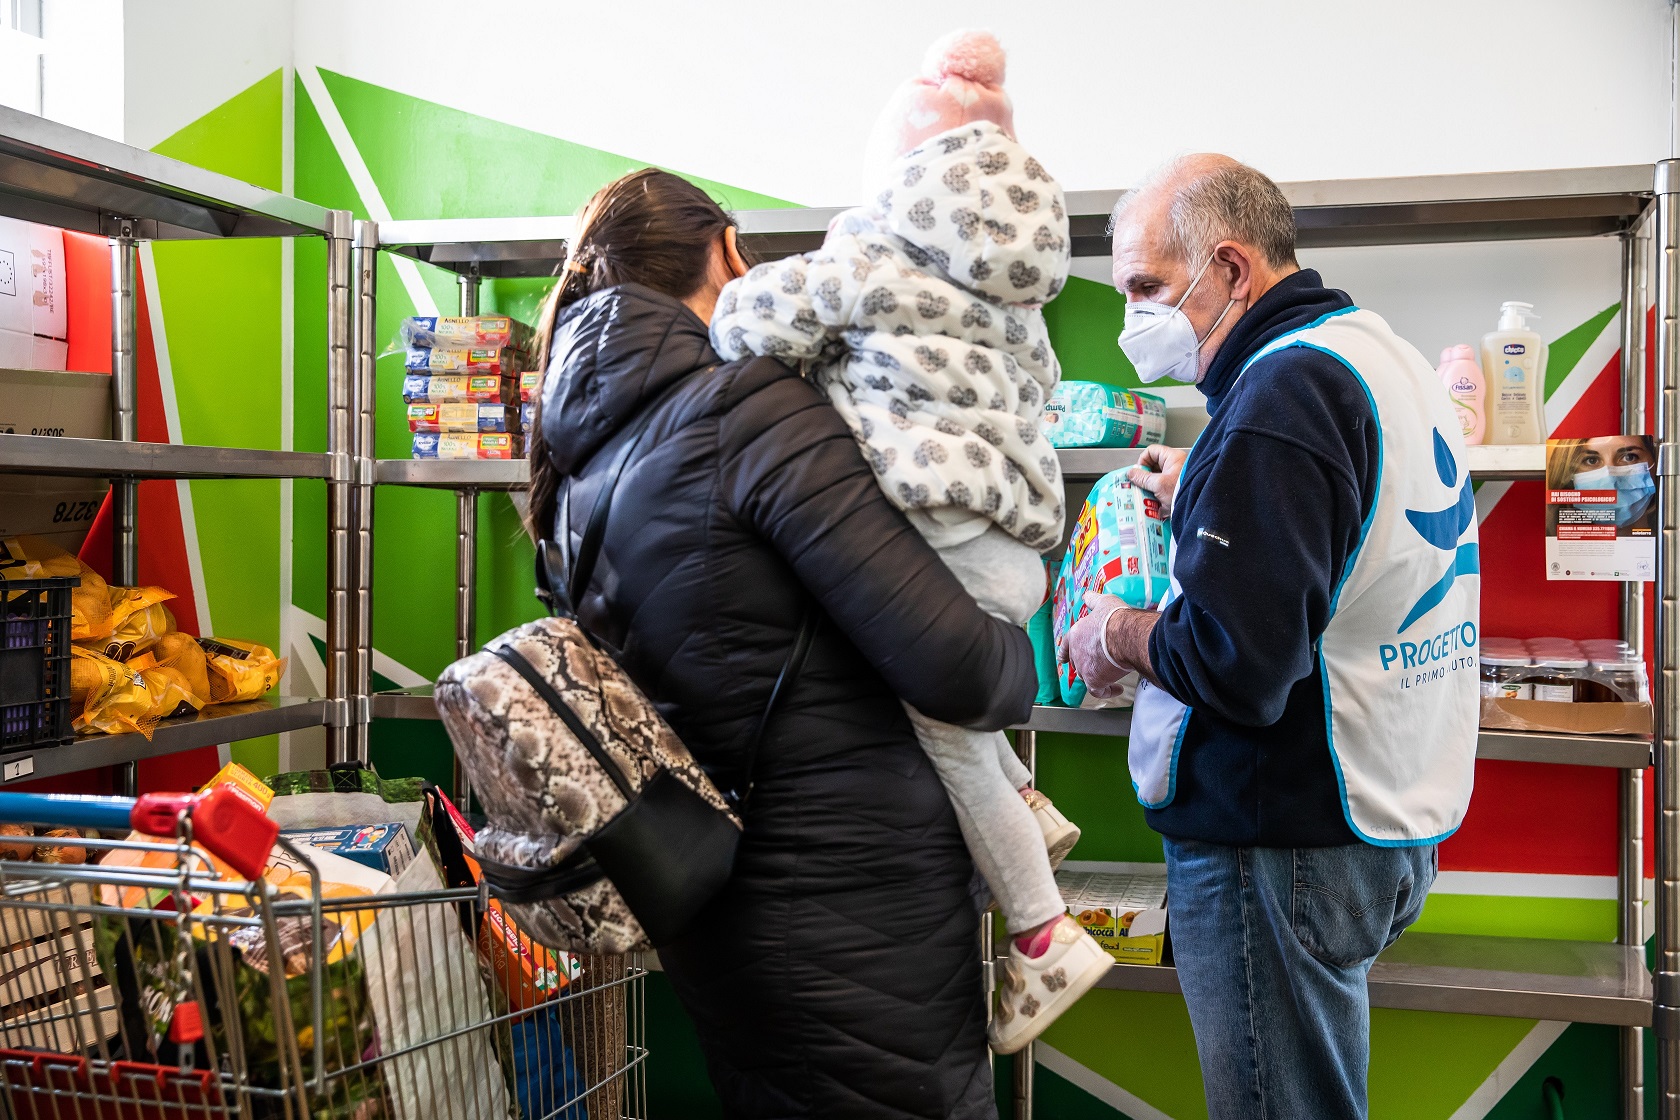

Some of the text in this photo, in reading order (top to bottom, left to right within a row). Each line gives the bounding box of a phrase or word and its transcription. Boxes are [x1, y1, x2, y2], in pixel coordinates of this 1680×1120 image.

[1504, 345, 1525, 353] chicco
[52, 501, 97, 523] 3278
[1380, 621, 1477, 671] PROGETTO
[1401, 656, 1477, 689] IL PRIMO UTO,
[14, 763, 20, 775] 1
[253, 782, 268, 794] 400
[1084, 927, 1114, 937] bicocca
